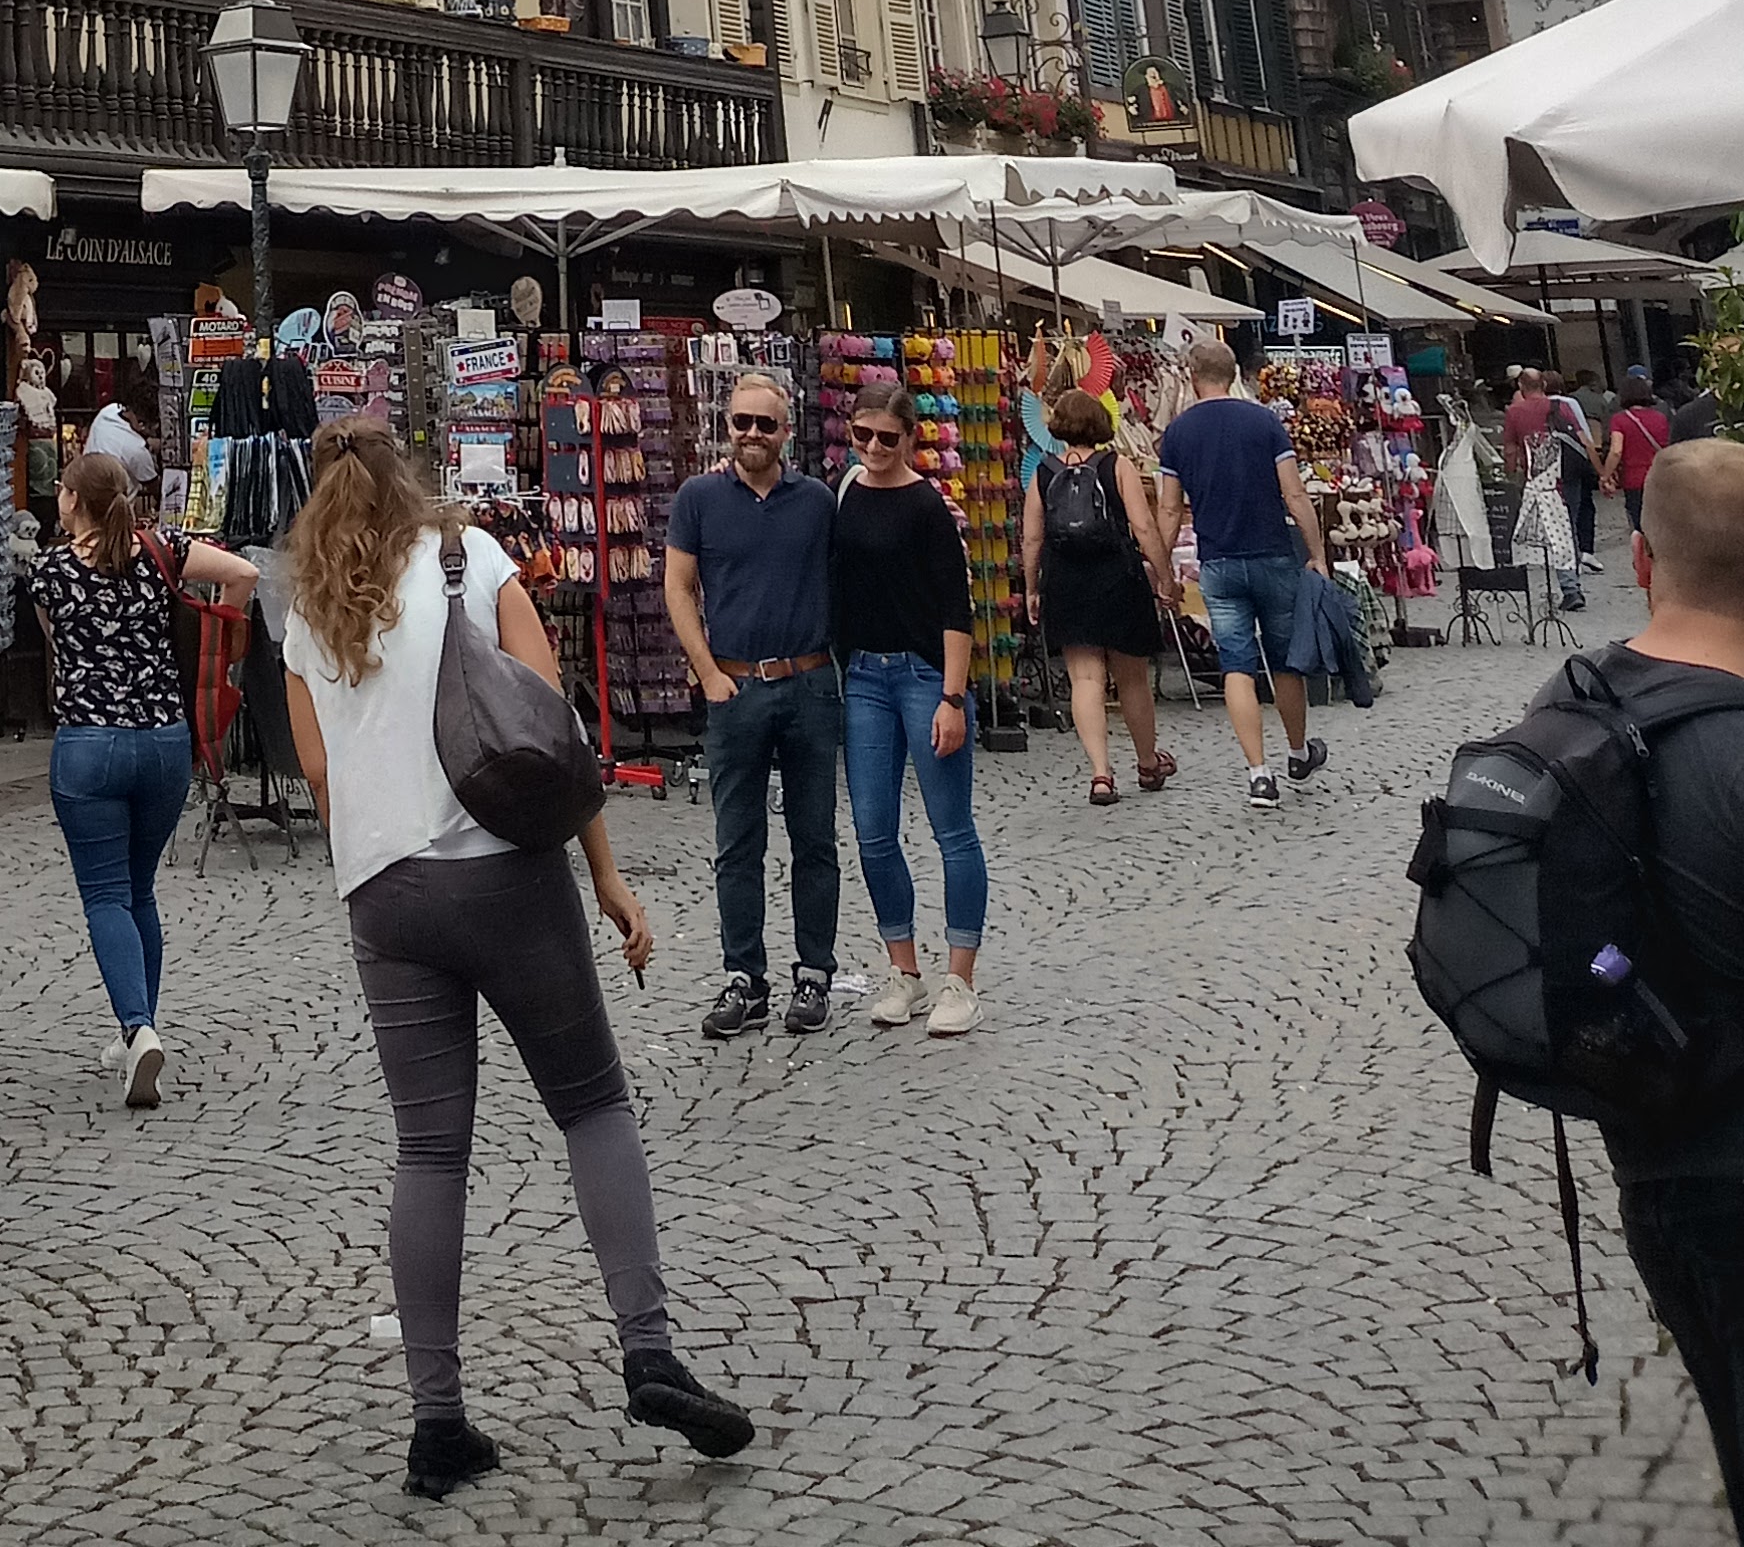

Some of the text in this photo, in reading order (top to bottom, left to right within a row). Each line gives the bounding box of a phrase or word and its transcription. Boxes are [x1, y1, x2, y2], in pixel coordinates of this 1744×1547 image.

[45, 235, 64, 261] LE
[107, 238, 173, 266] D'ALSACE
[198, 320, 240, 332] MOTARD
[464, 351, 506, 372] FRANCE
[201, 373, 218, 384] 40
[320, 375, 357, 386] CUISINE
[1465, 771, 1526, 805] DAKINE
